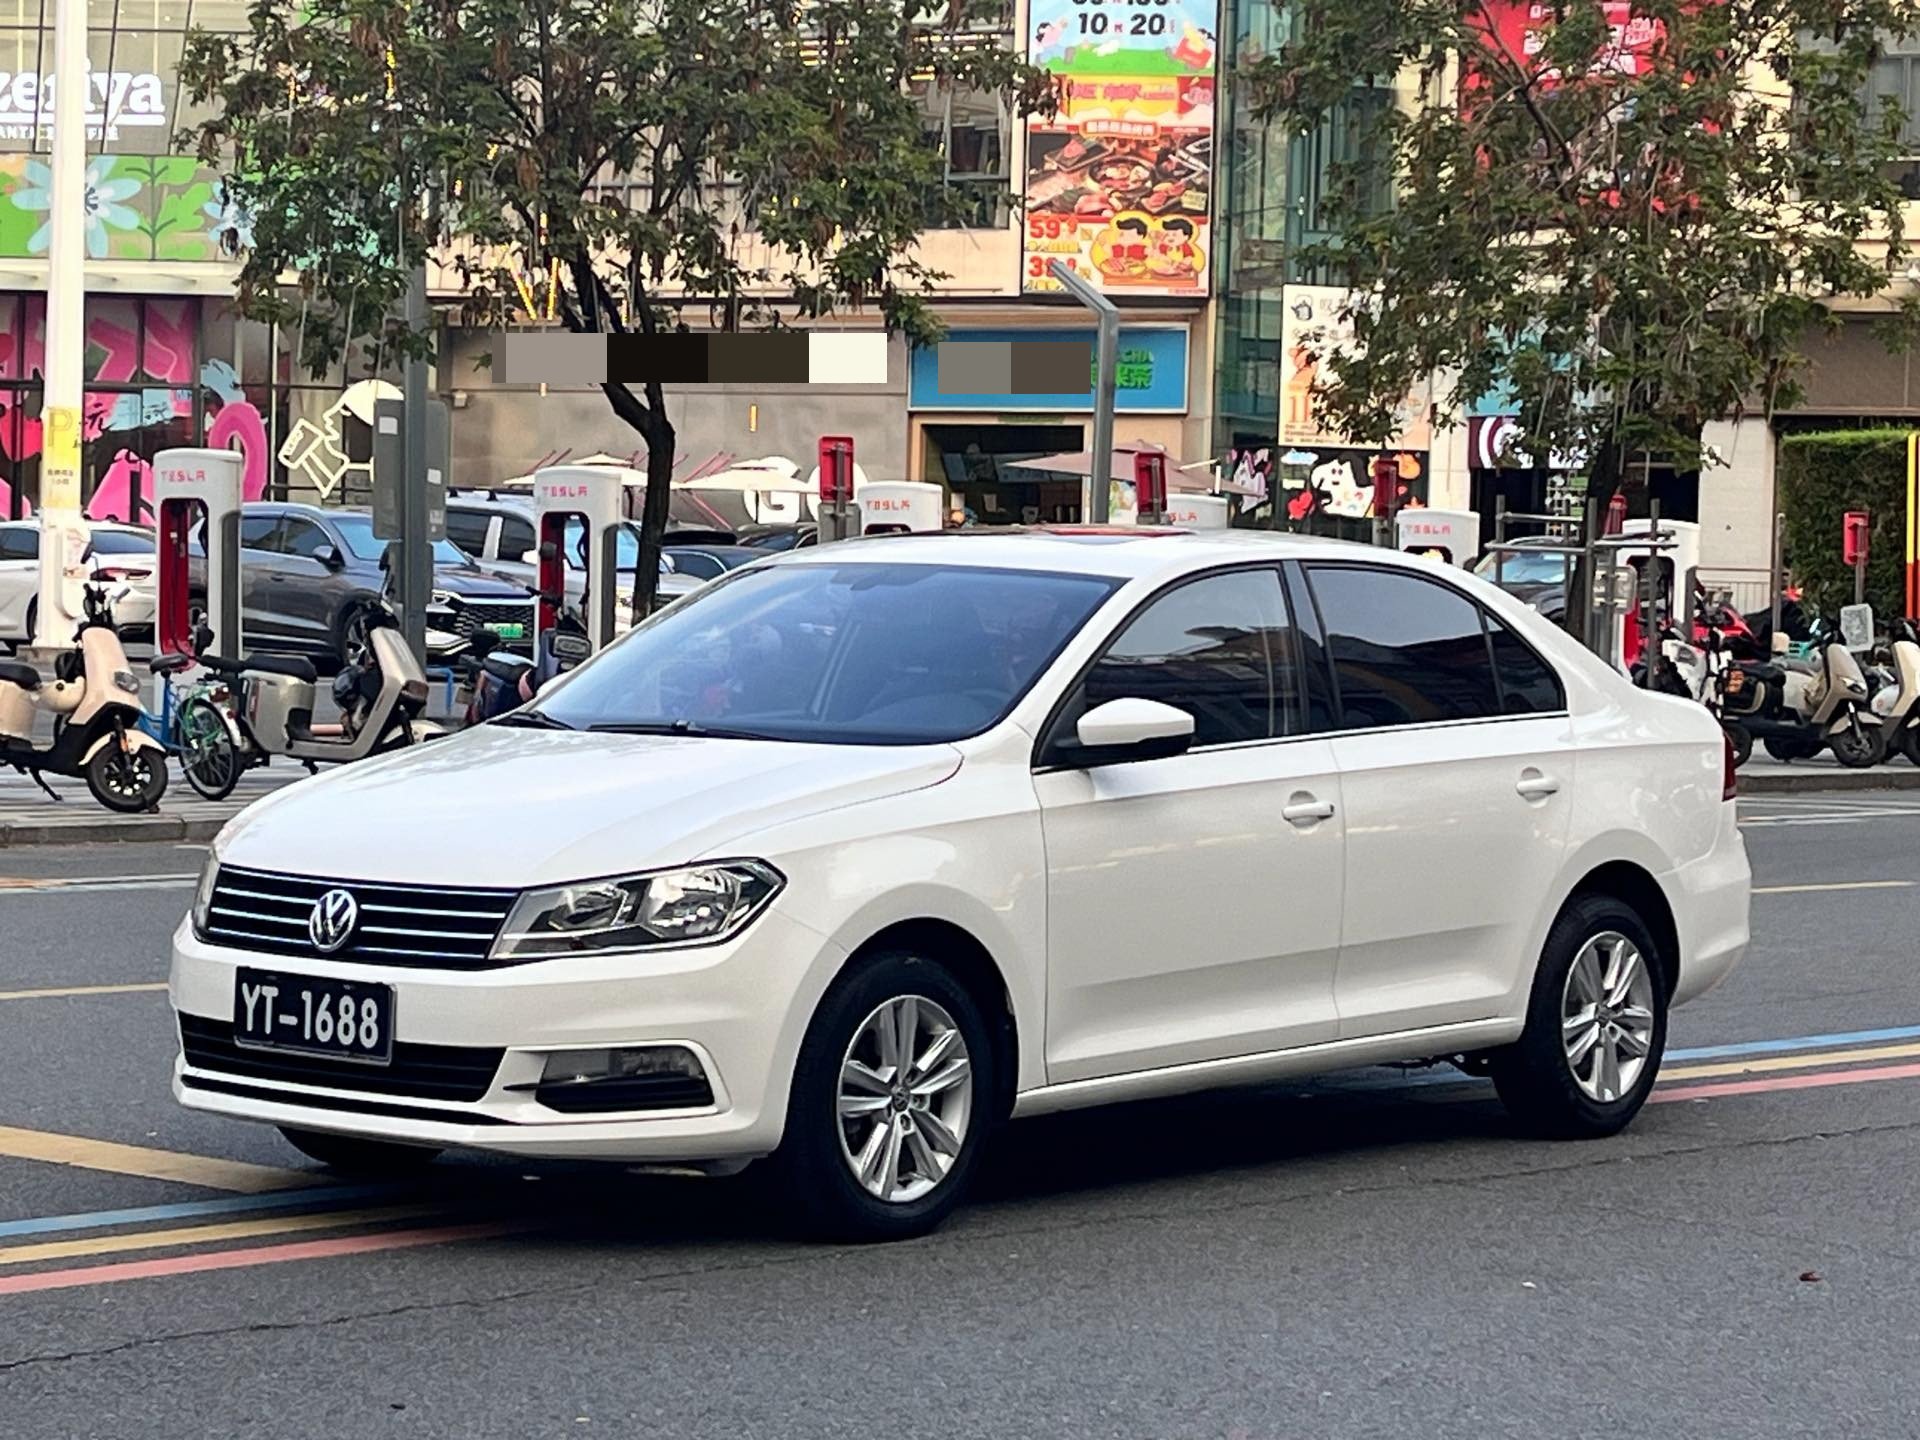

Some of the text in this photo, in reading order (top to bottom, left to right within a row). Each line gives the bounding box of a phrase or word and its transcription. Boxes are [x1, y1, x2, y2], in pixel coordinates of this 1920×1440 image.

[1079, 13, 1108, 34] 10
[1130, 13, 1165, 35] 20
[160, 469, 206, 482] TESLA
[542, 486, 588, 497] TESLA
[865, 501, 911, 511] TESLA
[1169, 512, 1198, 522] SLA
[1405, 523, 1451, 534] TESLA
[241, 982, 379, 1049] YT-1688
